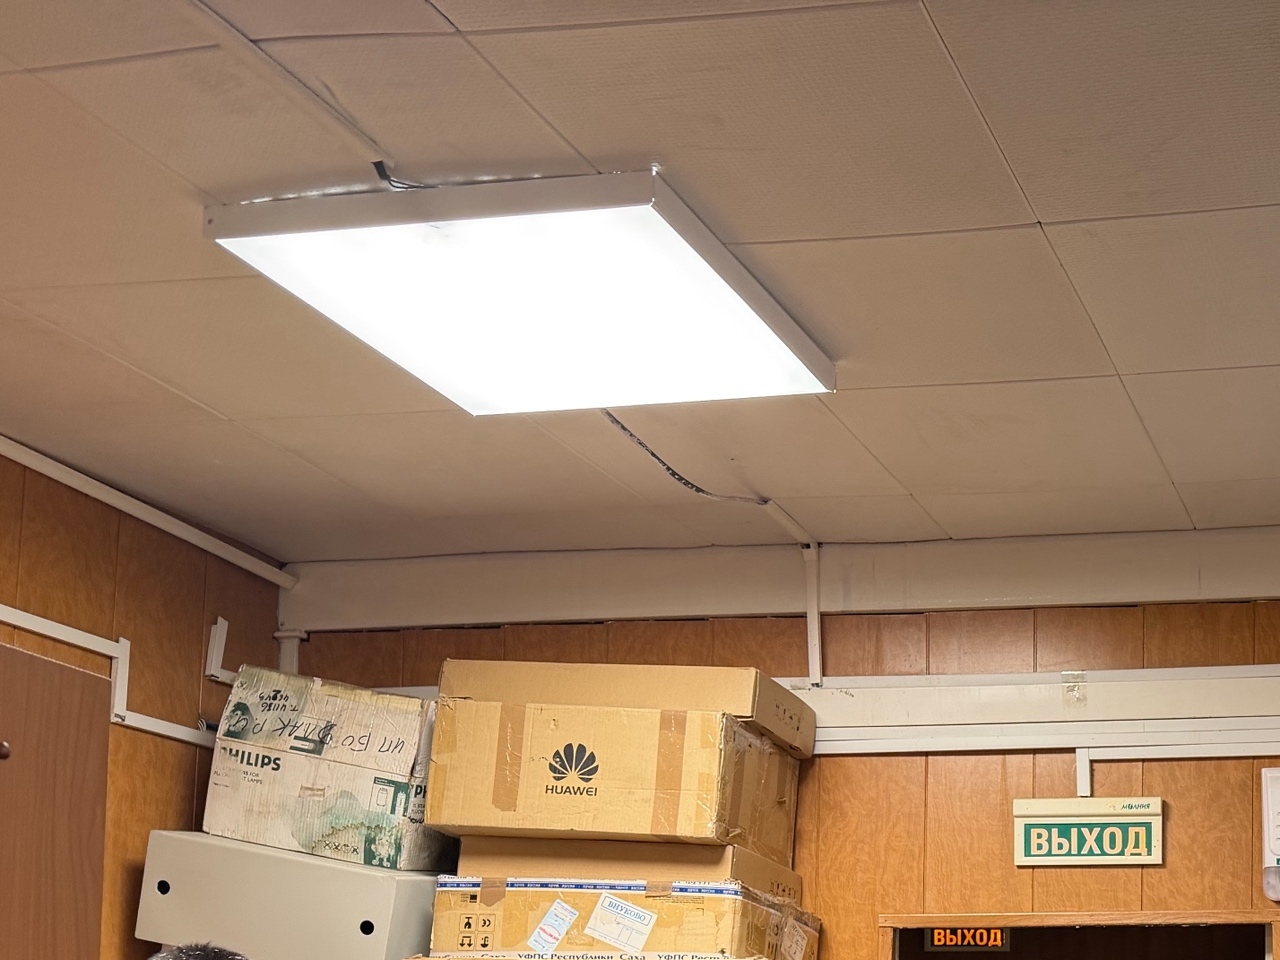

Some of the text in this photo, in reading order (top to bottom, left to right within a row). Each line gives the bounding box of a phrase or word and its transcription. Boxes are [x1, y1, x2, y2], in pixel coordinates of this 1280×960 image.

[220, 746, 282, 771] HILIPS
[545, 785, 598, 797] HUAWEI
[1030, 826, 1148, 857] ВЫХОД
[607, 898, 647, 924] ВНУКОВО
[933, 929, 1002, 947] ВЫХОД
